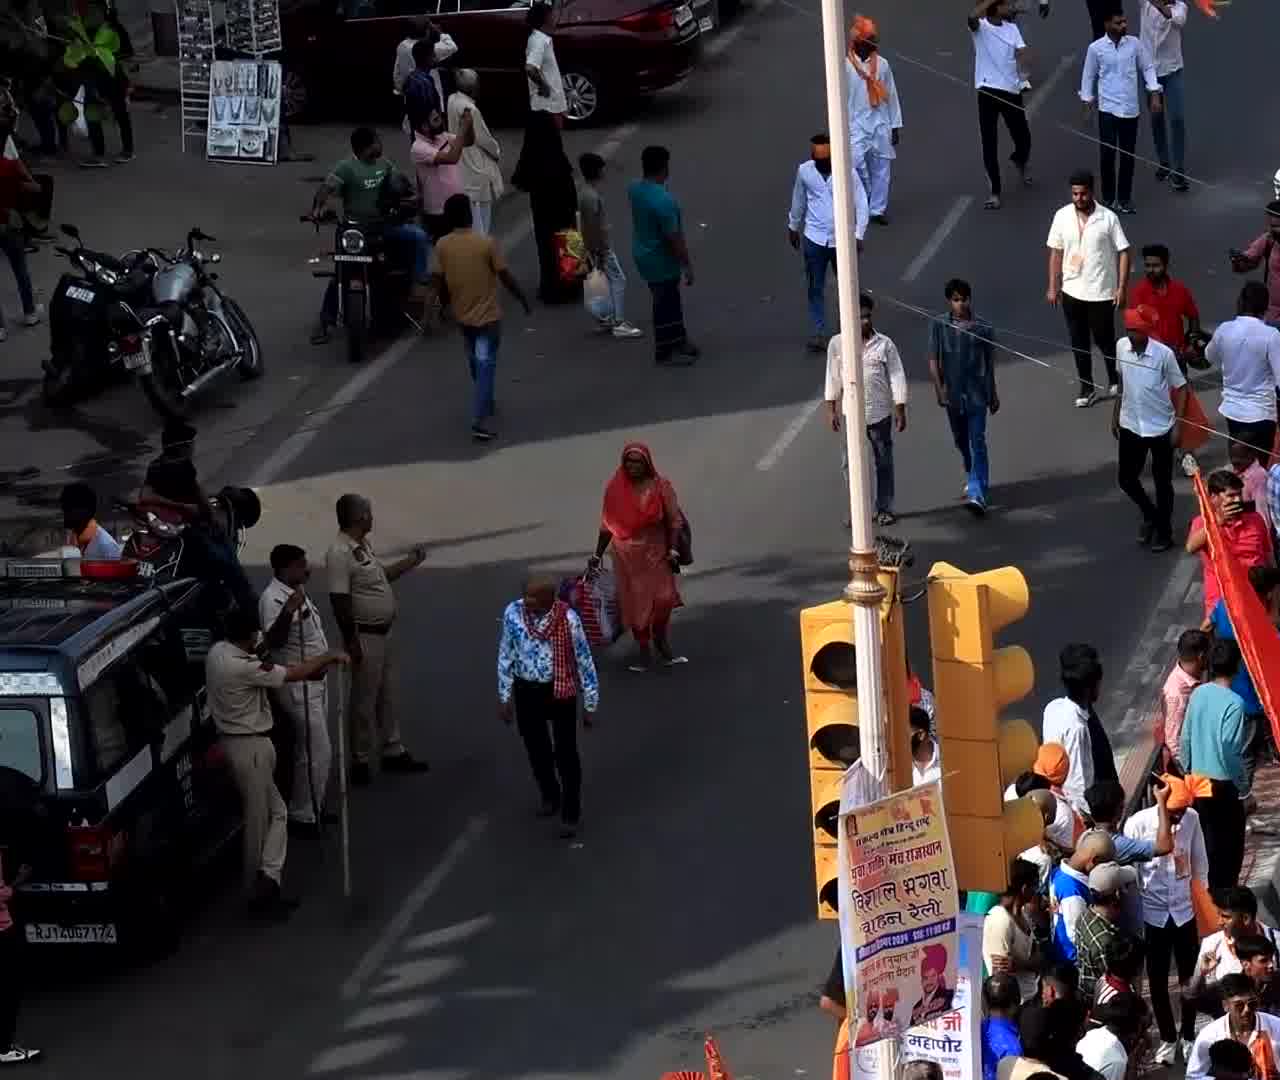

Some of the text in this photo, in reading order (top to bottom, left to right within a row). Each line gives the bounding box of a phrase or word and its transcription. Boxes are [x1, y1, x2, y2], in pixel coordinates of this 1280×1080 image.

[904, 840, 942, 862] राजस्थान
[852, 868, 950, 916] विशाल भगवा
[861, 912, 906, 935] वाहन
[942, 1012, 962, 1032] जी
